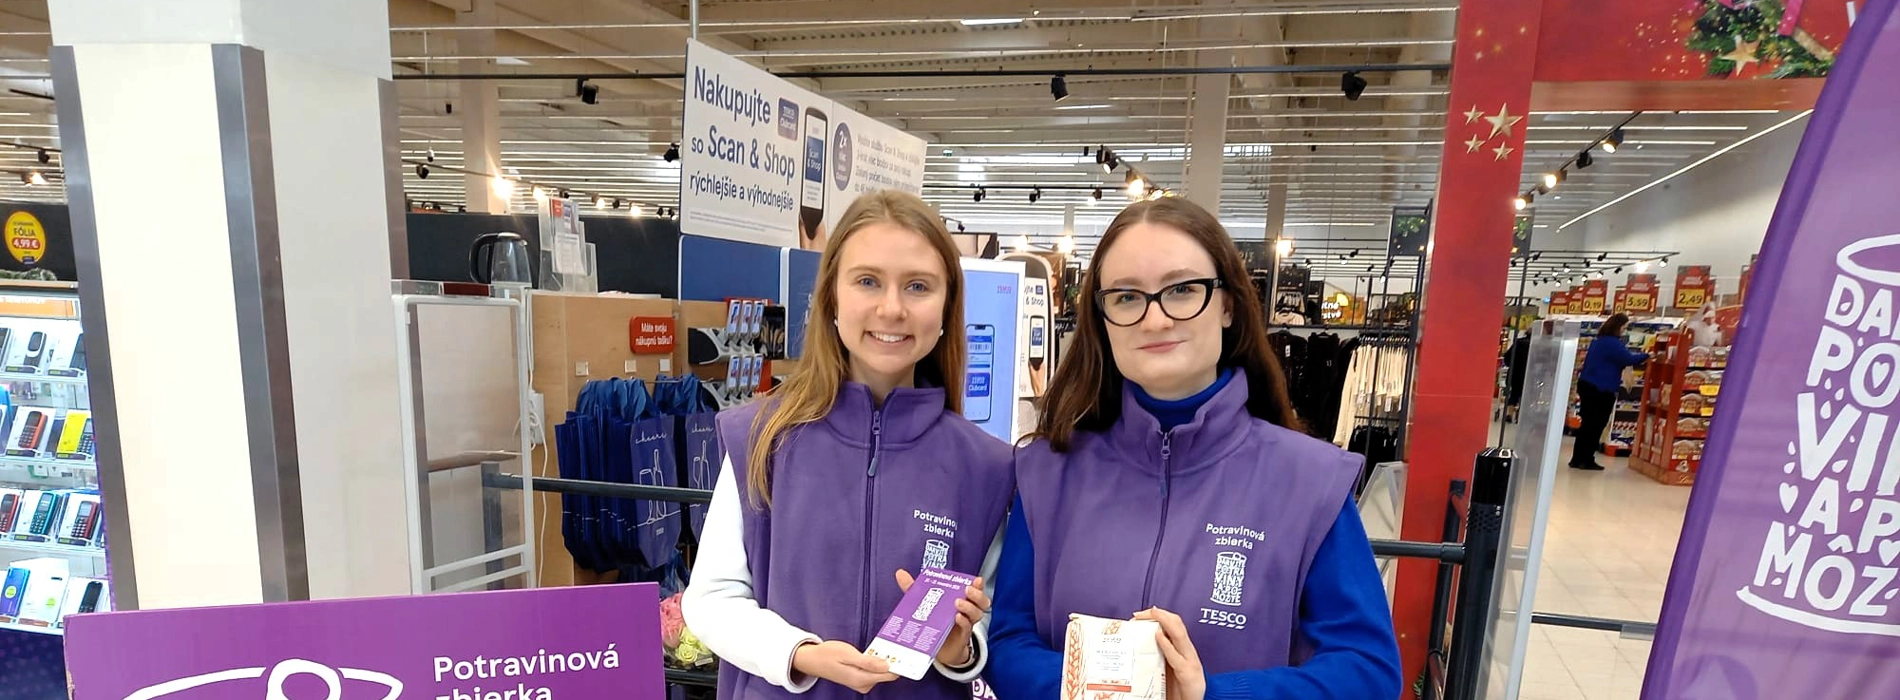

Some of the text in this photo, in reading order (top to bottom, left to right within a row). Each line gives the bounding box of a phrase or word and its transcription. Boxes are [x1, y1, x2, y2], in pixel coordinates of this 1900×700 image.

[694, 66, 771, 127] Nakupujte
[691, 125, 795, 185] so Scan & Shop
[690, 171, 736, 200] rýchlejšie
[739, 186, 745, 200] a
[747, 184, 794, 213] výhodnejšie
[1824, 274, 1900, 341] DA
[1206, 523, 1265, 541] Potravinová
[1215, 536, 1253, 549] zbierka
[1200, 608, 1247, 625] TESCO
[433, 643, 620, 682] Potravinová
[435, 683, 552, 700] ierka
